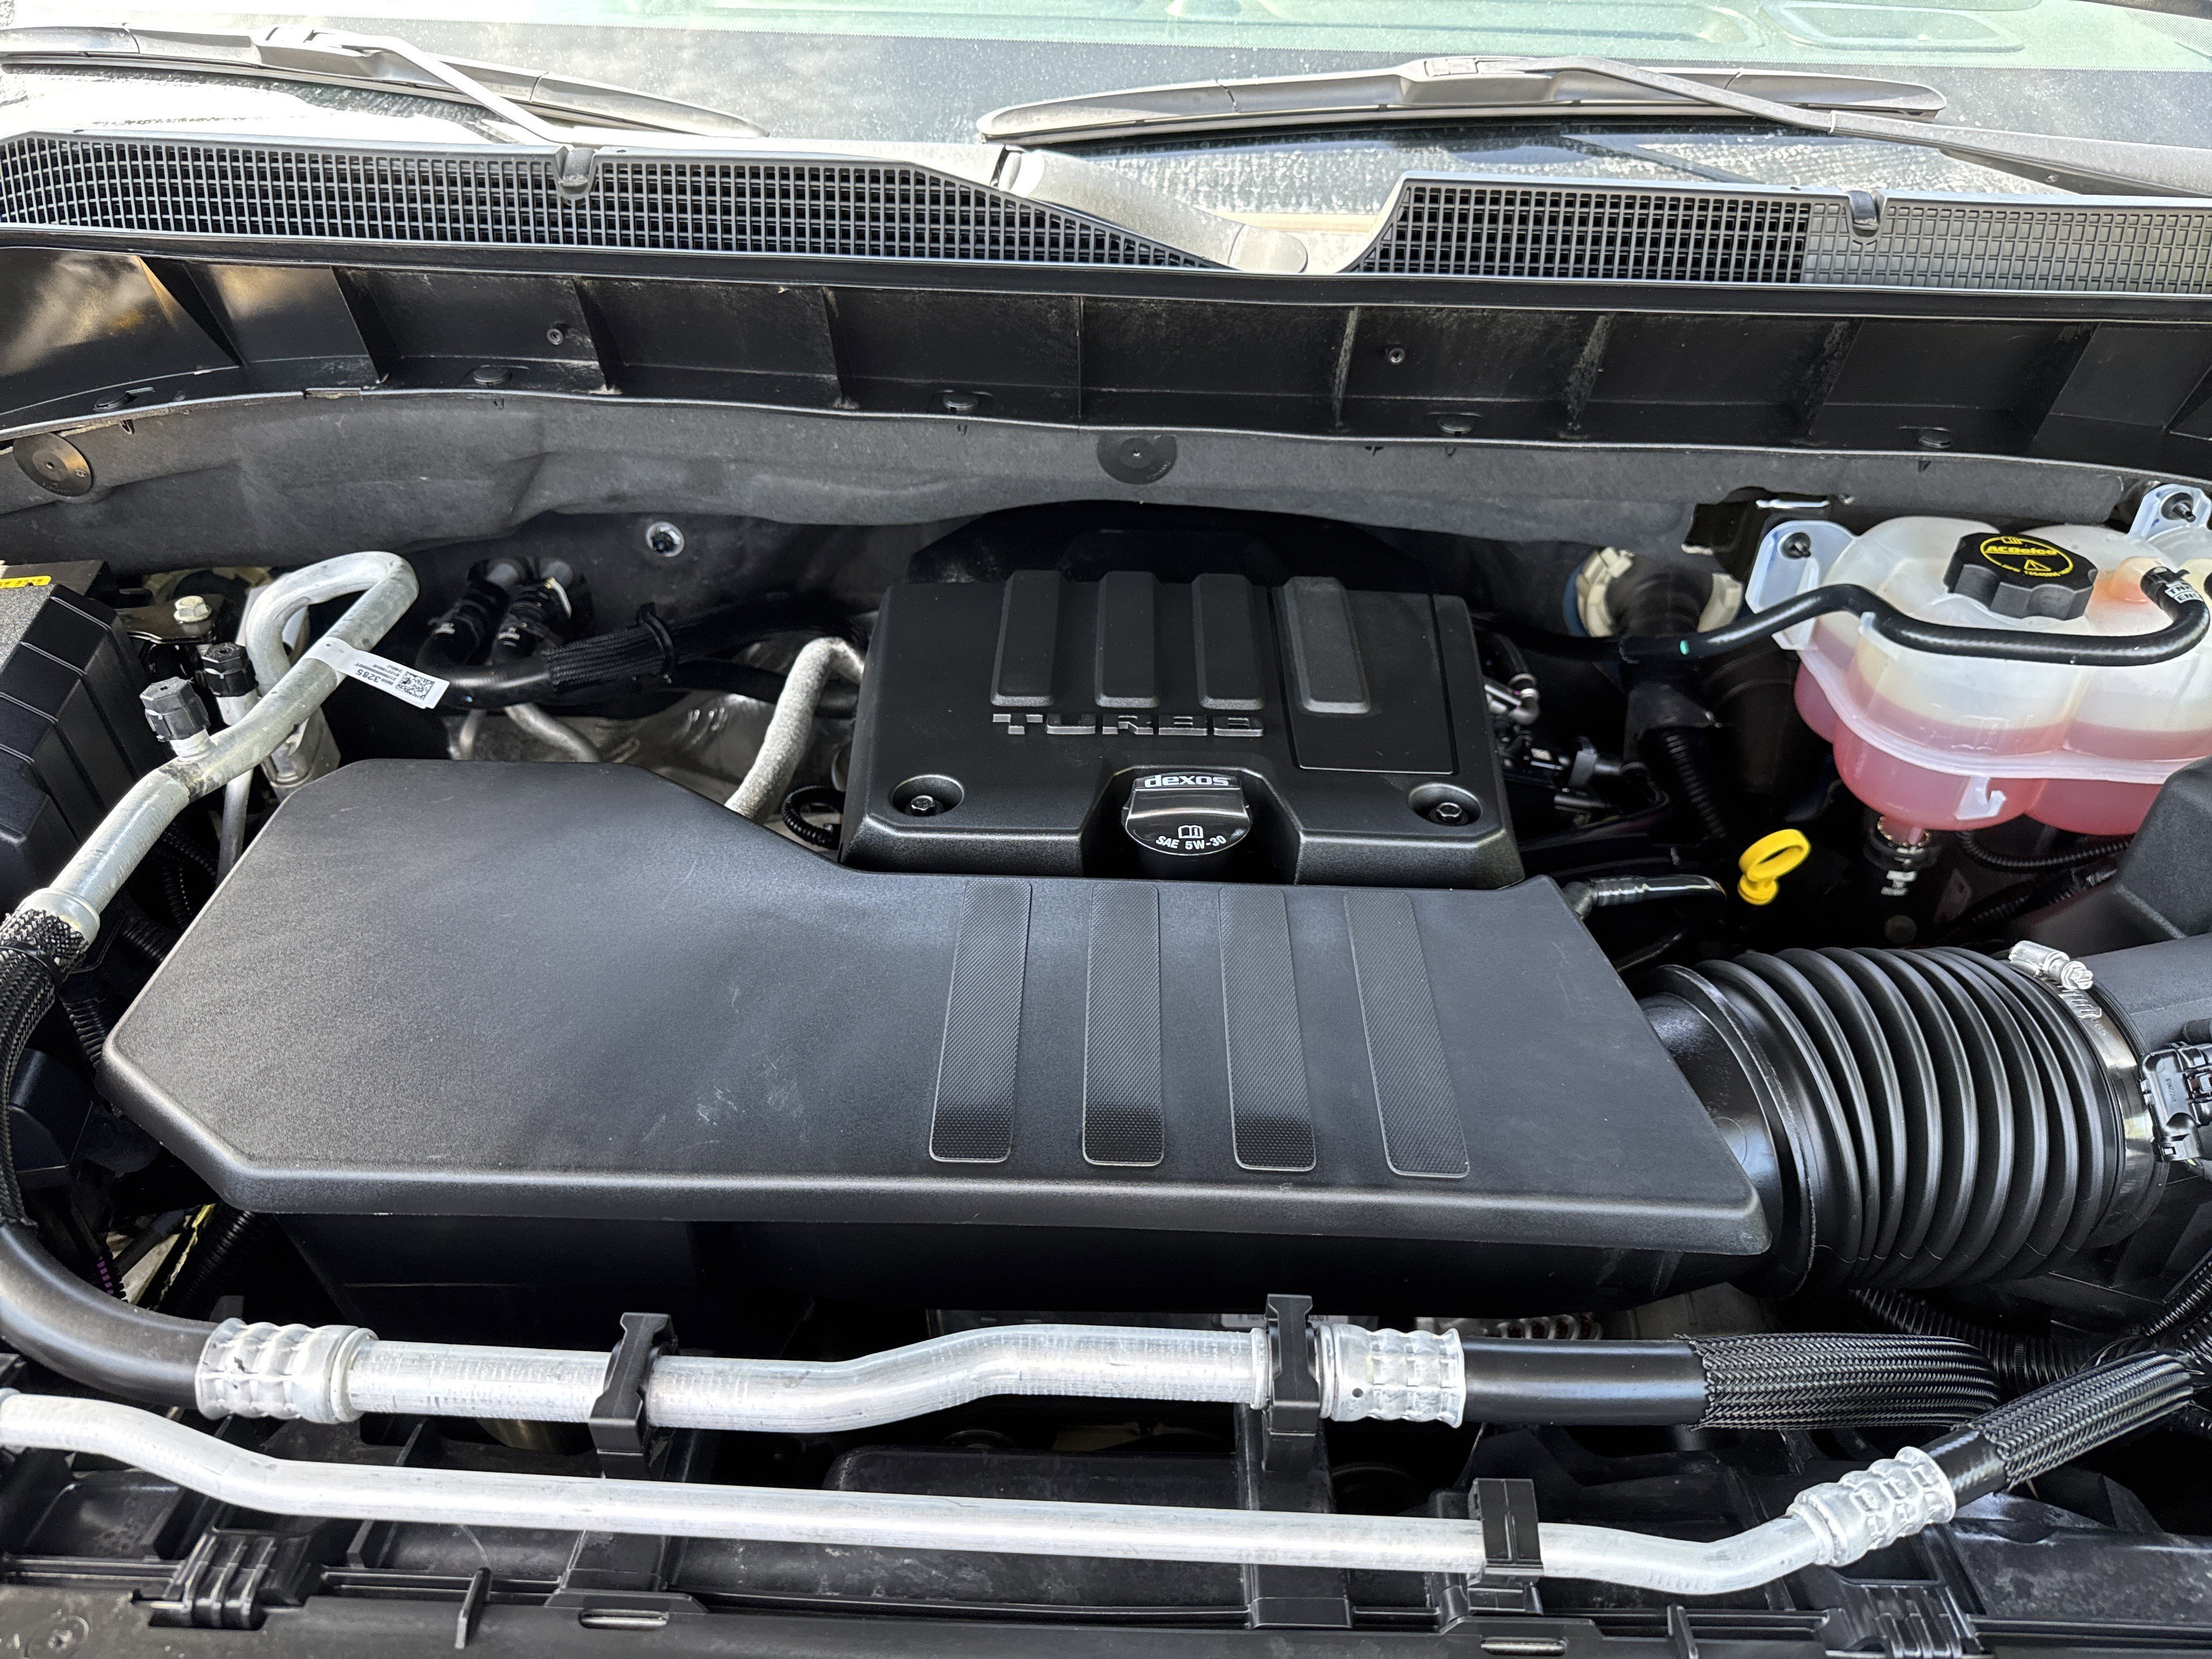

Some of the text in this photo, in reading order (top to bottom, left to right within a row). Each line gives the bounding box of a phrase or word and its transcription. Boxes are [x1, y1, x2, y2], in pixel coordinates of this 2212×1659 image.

[1985, 545, 2057, 555] ACDelco
[992, 713, 1263, 736] TURBO
[1144, 775, 1229, 788] dexos
[1155, 835, 1227, 850] SAE 5W-30
